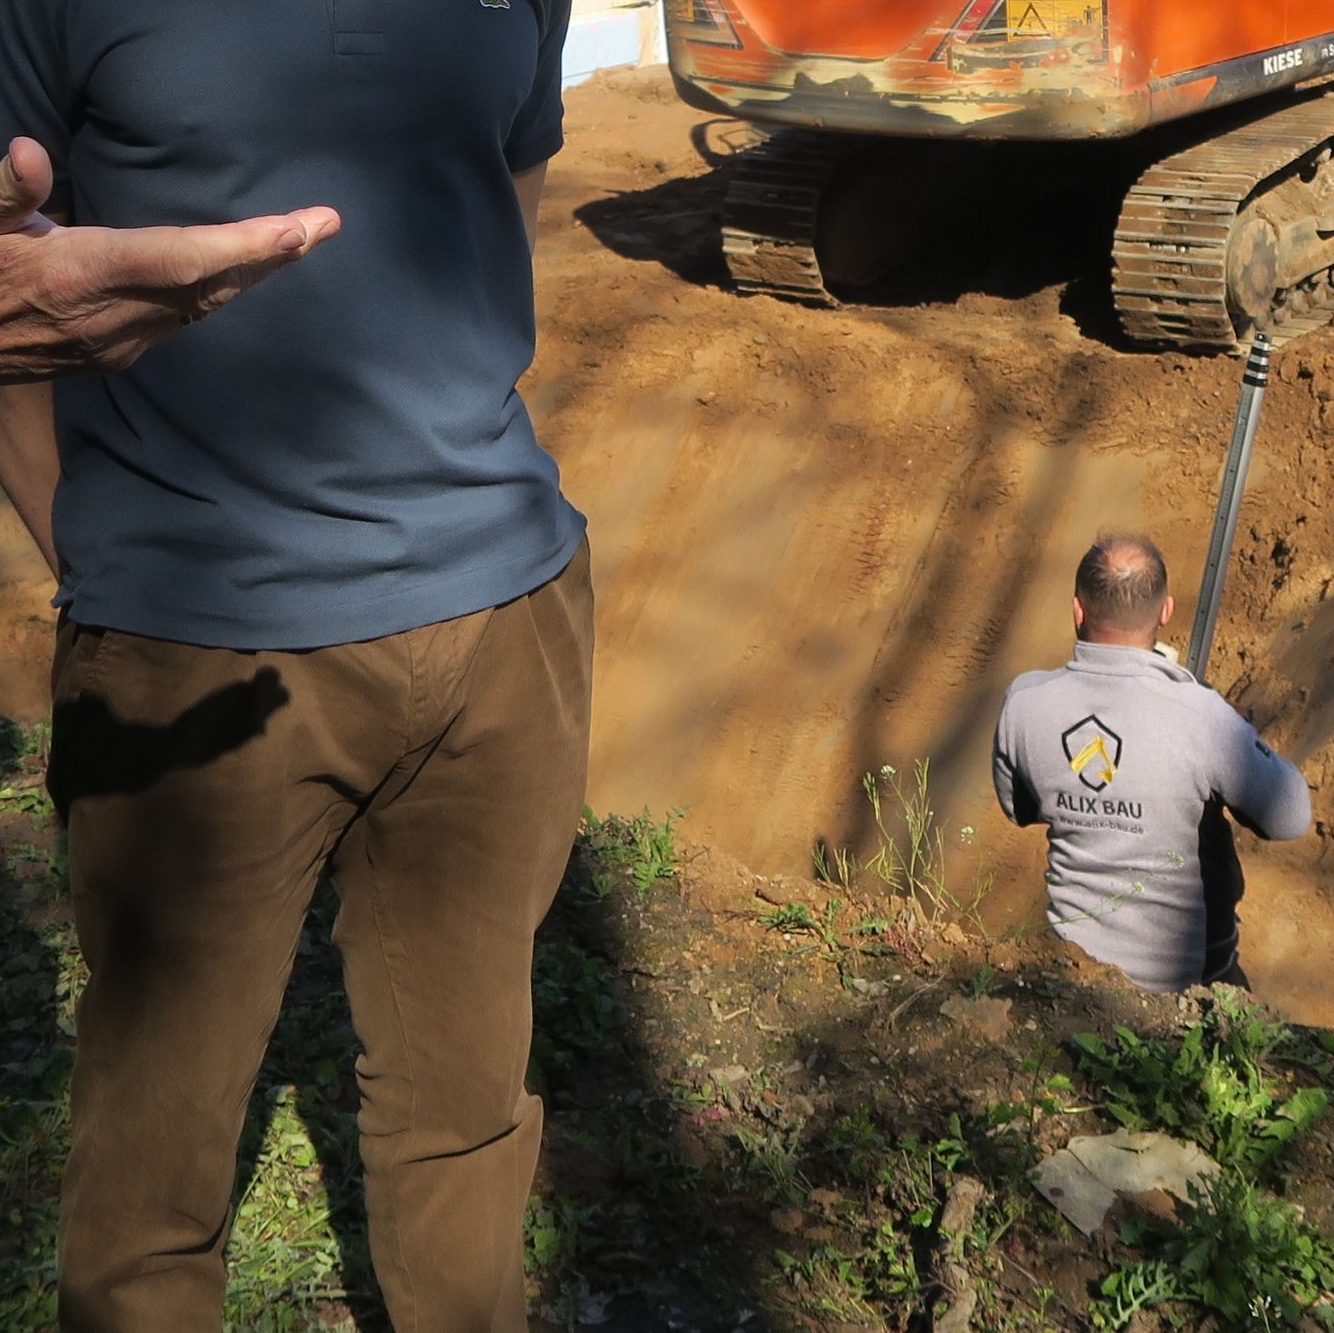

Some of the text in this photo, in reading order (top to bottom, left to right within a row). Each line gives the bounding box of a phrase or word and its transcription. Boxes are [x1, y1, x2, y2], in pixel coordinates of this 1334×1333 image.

[1263, 48, 1303, 75] KIESE
[1057, 793, 1142, 819] ALIX BAU
[1059, 816, 1144, 835] www.alix-bau.de
